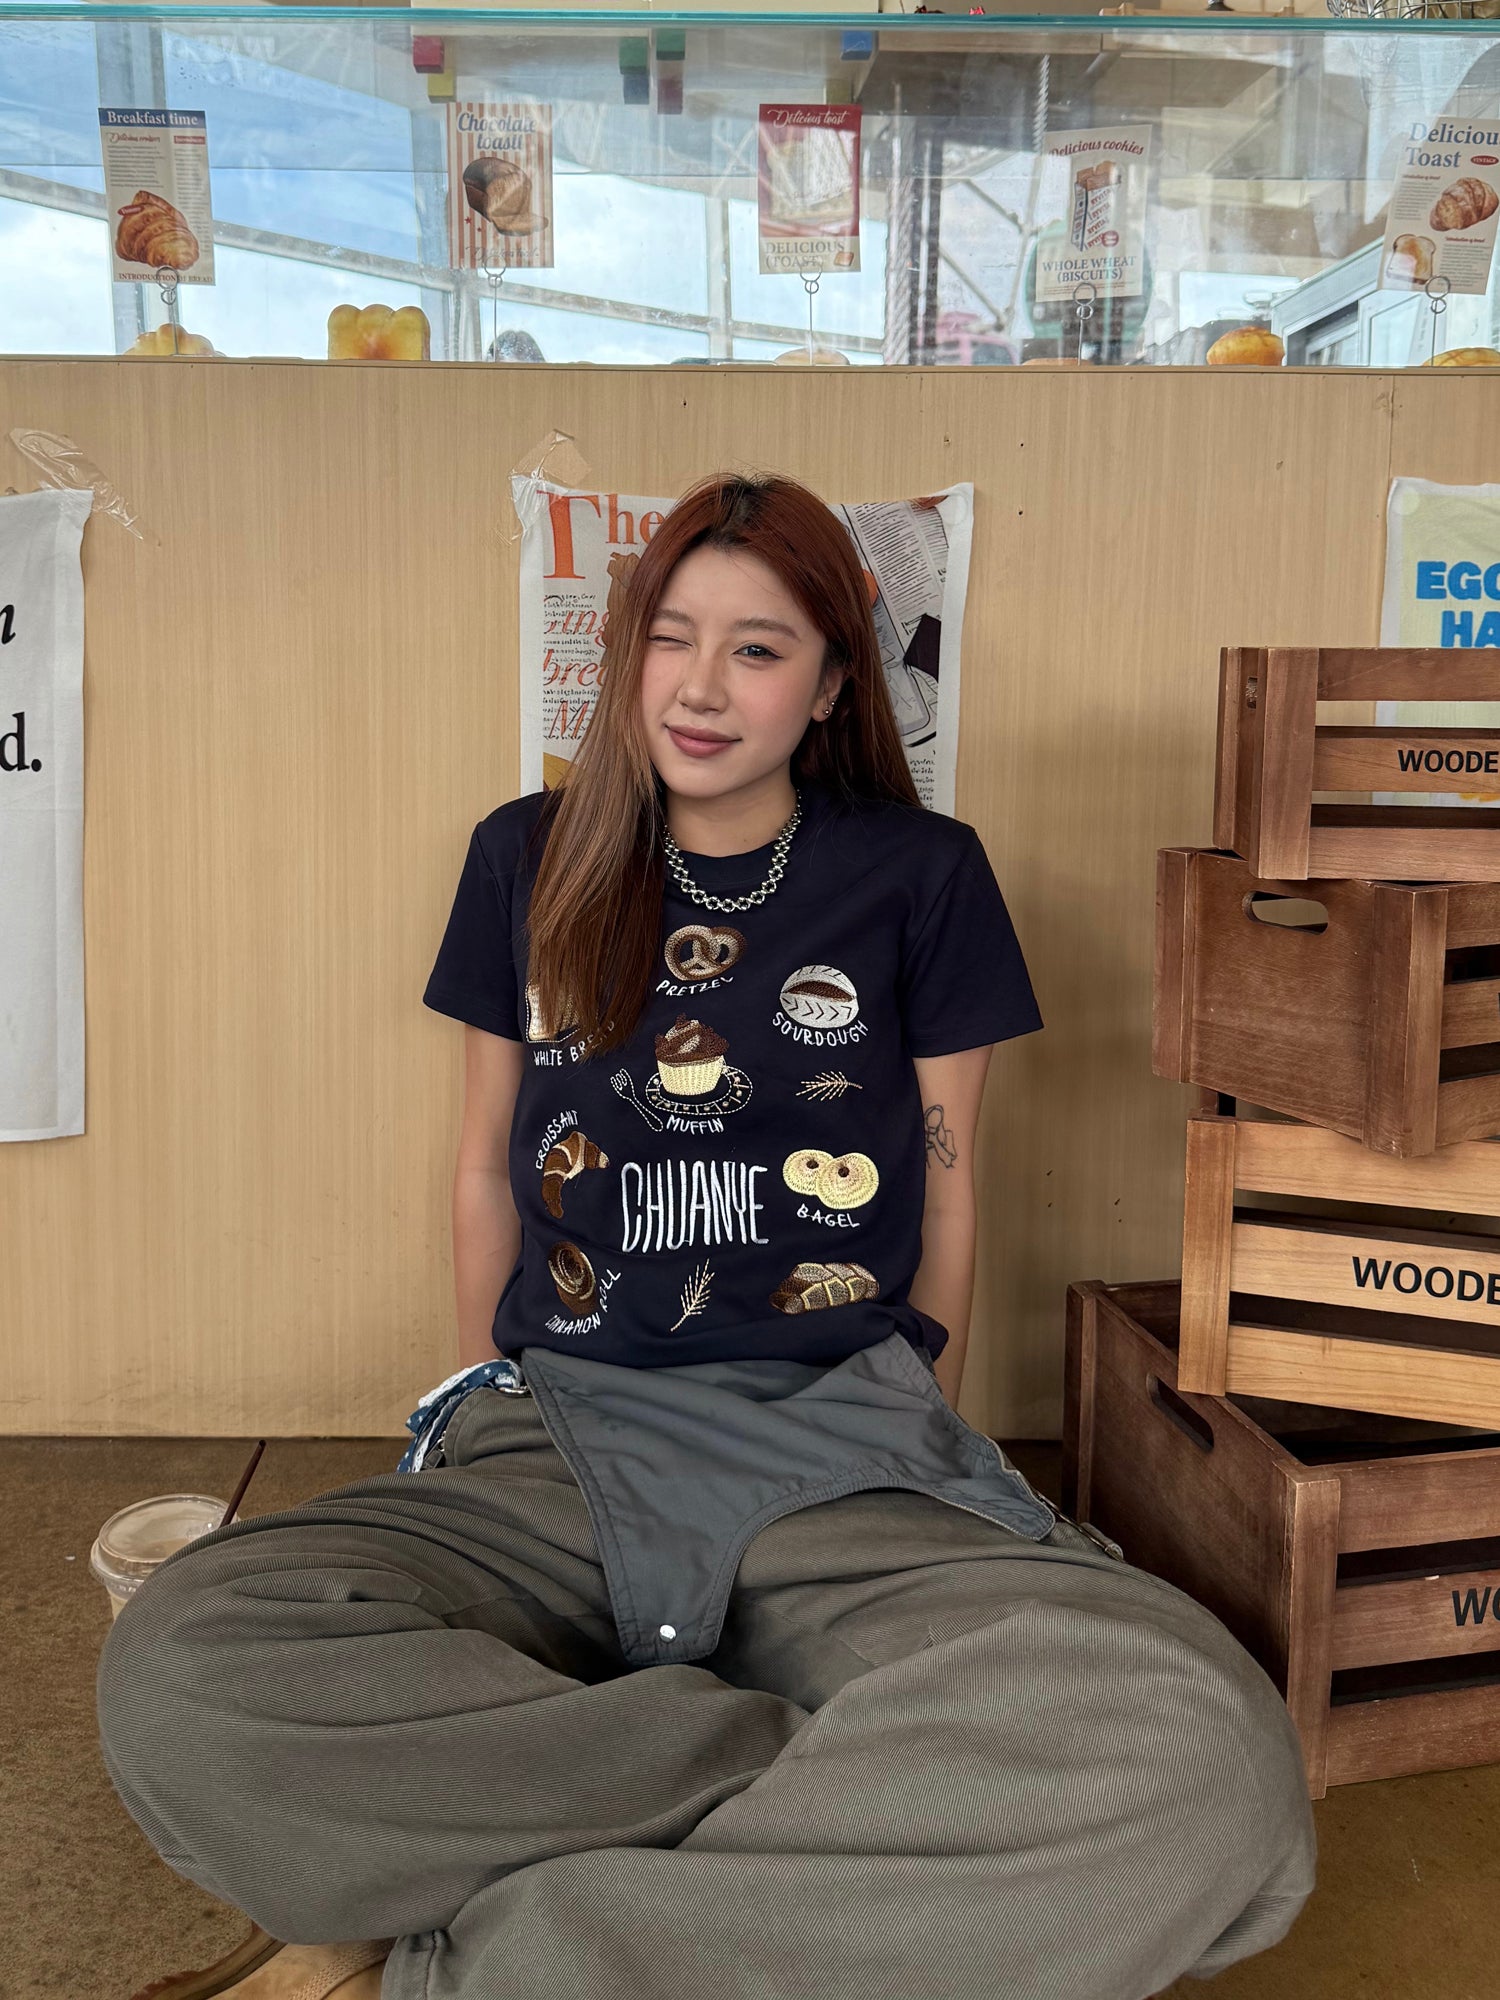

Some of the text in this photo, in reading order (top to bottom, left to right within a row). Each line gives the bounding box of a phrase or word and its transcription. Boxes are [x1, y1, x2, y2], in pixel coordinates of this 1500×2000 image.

[107, 111, 199, 125] Breakfast time
[458, 112, 536, 133] Chocolate
[767, 109, 850, 129] Delicious toast
[1410, 122, 1500, 146] Deliciou
[1103, 140, 1144, 155] cookies
[1406, 146, 1461, 168] Toast
[765, 241, 844, 254] DELICIOUS
[1042, 256, 1137, 272] WHOLE WHEAT
[1057, 267, 1123, 283] (BISCUITS)
[536, 489, 666, 579] The
[1398, 749, 1499, 773] WOODE
[656, 976, 734, 996] PRETZEL
[772, 1012, 868, 1046] SOURDOUGH
[533, 1049, 562, 1066] WHITE
[666, 1114, 724, 1135] MUFFIN
[535, 1109, 579, 1169] CROISSANT
[621, 1159, 769, 1253] CHUANYE
[796, 1203, 860, 1228] BAGEL
[1352, 1256, 1500, 1305] WOODE
[545, 1268, 621, 1335] CINNAMON ROLL
